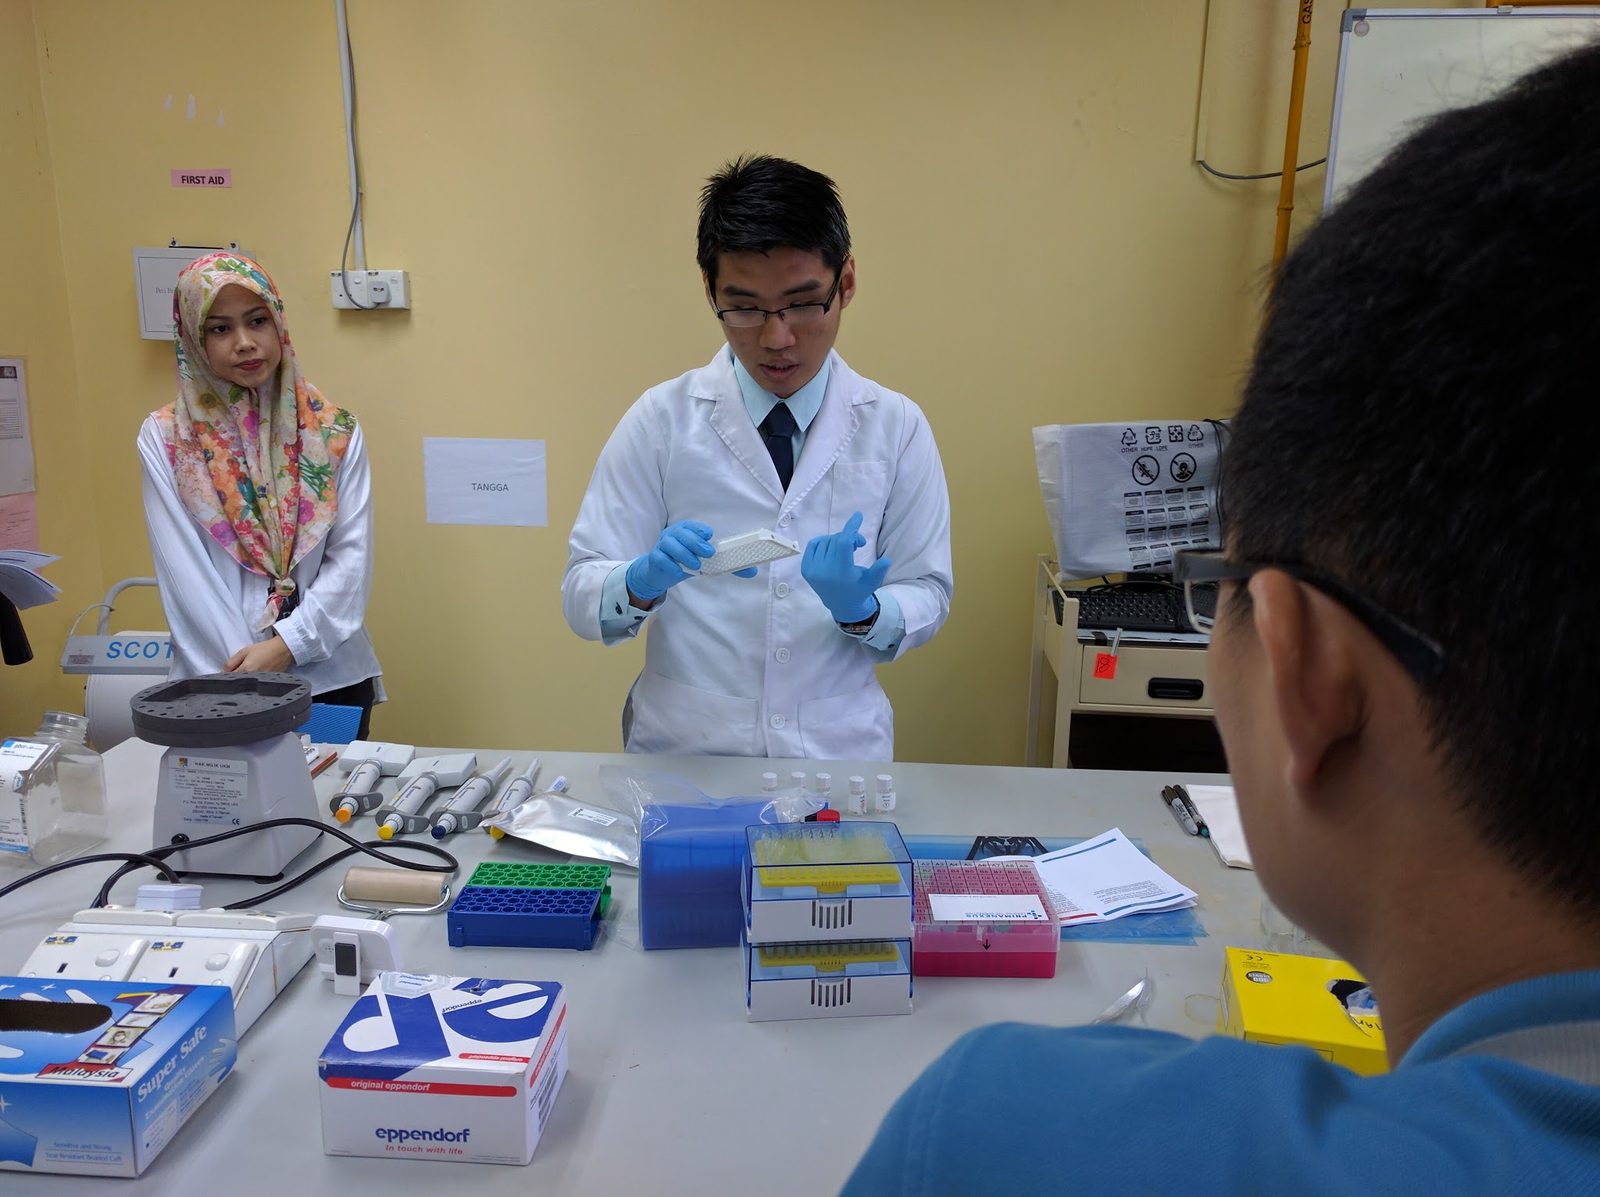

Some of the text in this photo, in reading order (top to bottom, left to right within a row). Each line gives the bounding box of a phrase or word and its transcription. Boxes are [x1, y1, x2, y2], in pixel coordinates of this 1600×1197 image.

[181, 175, 225, 185] FIRST AID
[471, 482, 509, 491] TANGGA
[442, 998, 483, 1013] eppendorf
[138, 1054, 178, 1103] Super
[180, 1026, 207, 1060] Safe
[50, 1066, 120, 1078] Malaysia
[350, 1079, 431, 1092] original eppendorf
[375, 1127, 470, 1143] eppendorf
[397, 1145, 423, 1153] touch
[426, 1146, 446, 1154] with
[448, 1147, 463, 1155] life
